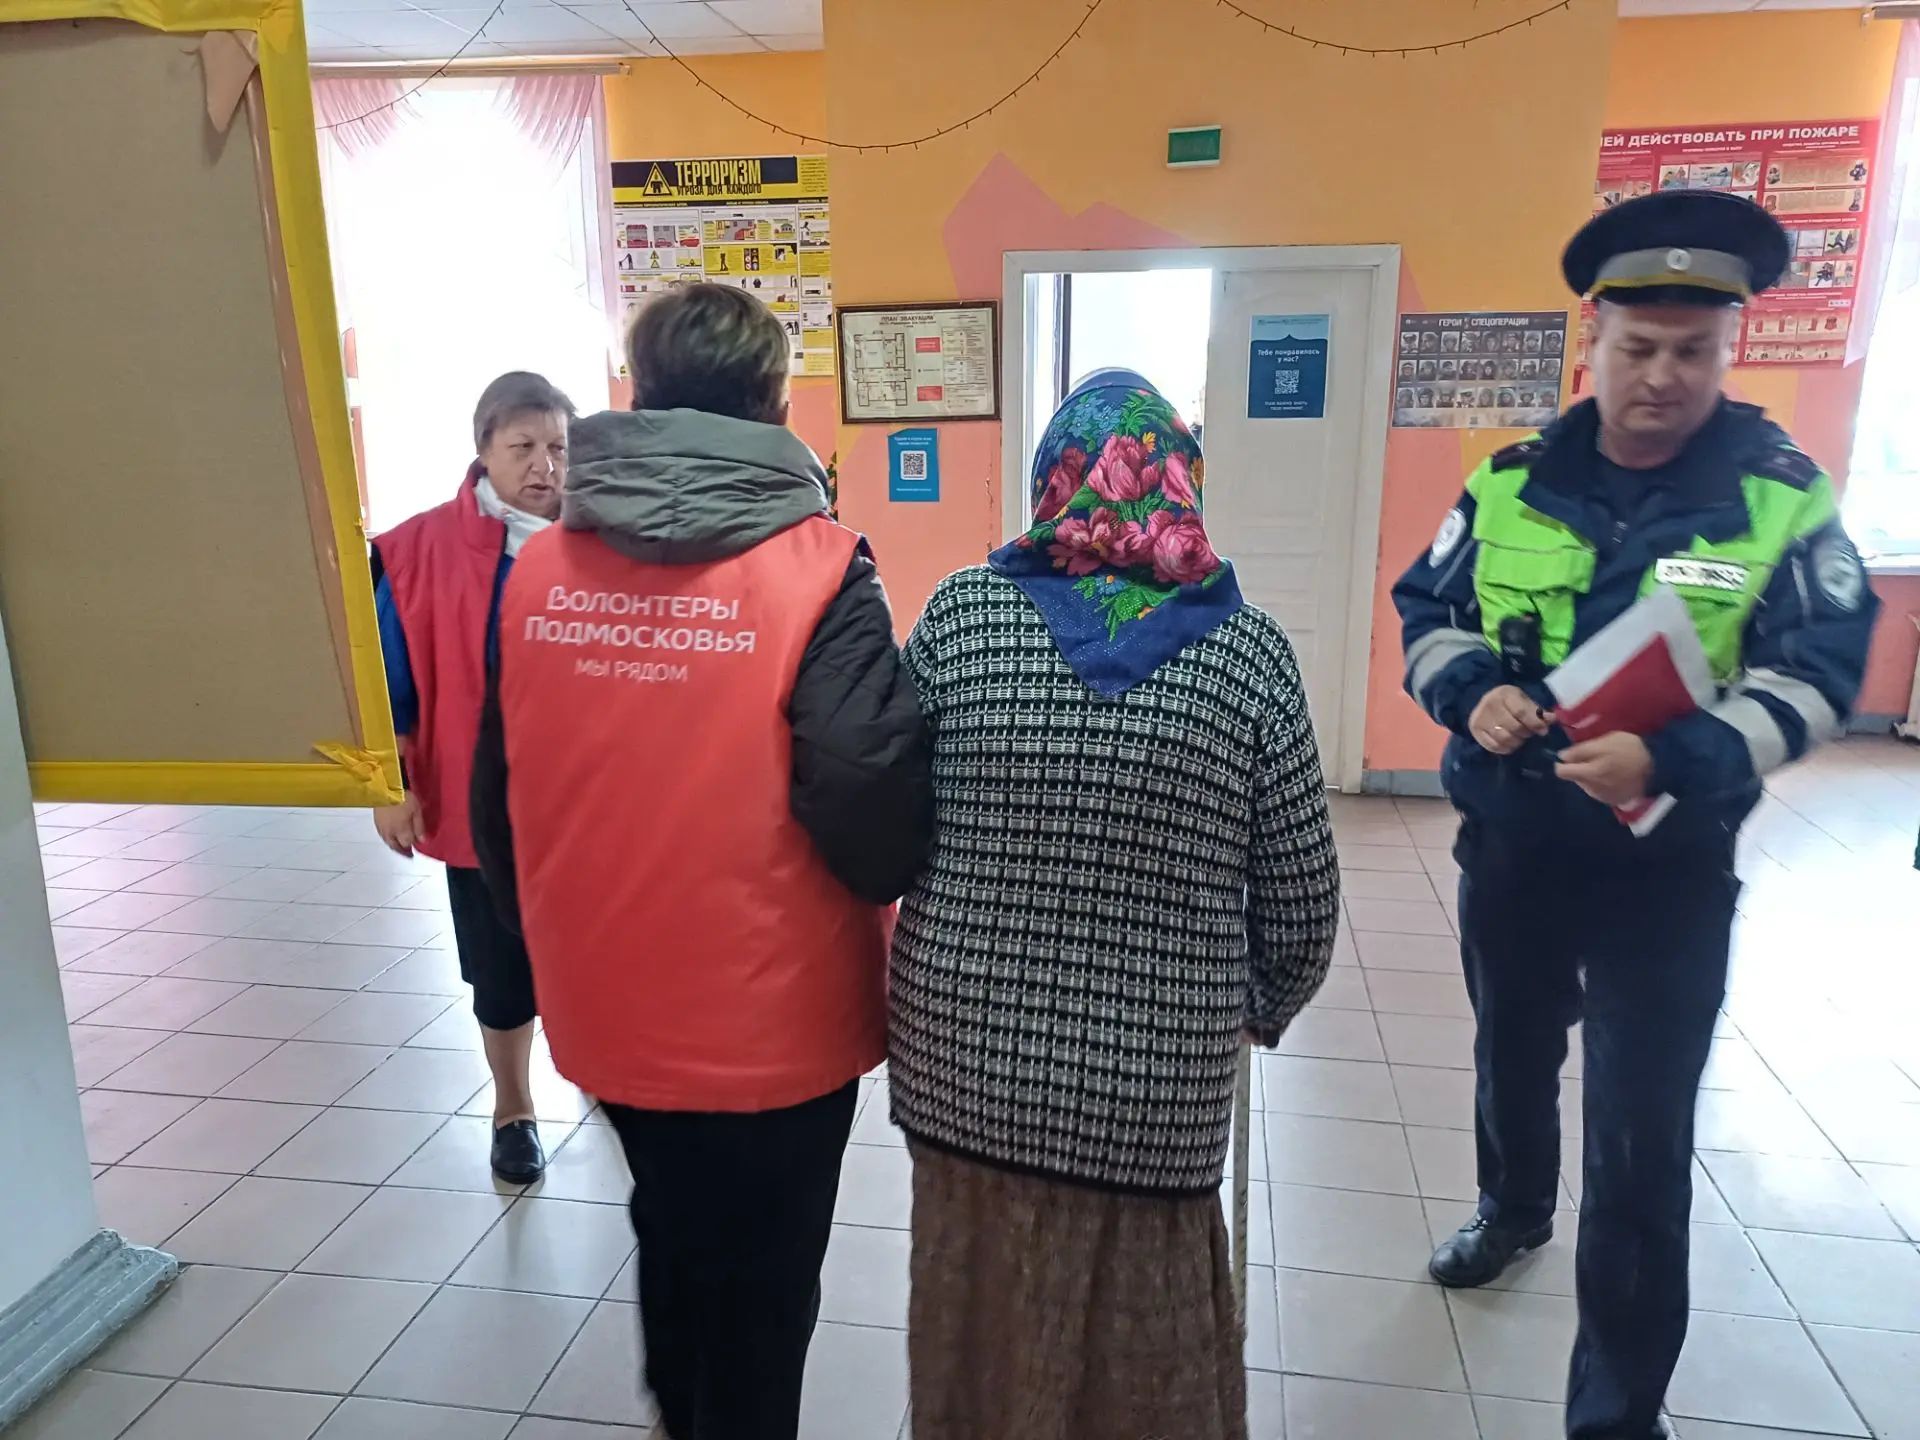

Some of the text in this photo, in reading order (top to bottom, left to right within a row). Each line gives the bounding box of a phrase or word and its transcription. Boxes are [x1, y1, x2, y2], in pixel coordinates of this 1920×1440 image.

[1600, 126, 1859, 148] ЕЙ ДЕЙСТВОВАТЬ ПРИ ПОЖАРЕ
[674, 160, 762, 186] ТЕРРОРИЗМ
[677, 184, 762, 196] УГРОЗА ДЛЯ КАЖДОГО
[1438, 317, 1529, 328] ГЕРОИ СПЕЦОПЕРАЦИИ
[574, 658, 689, 683] МЫ РЯДОМ
